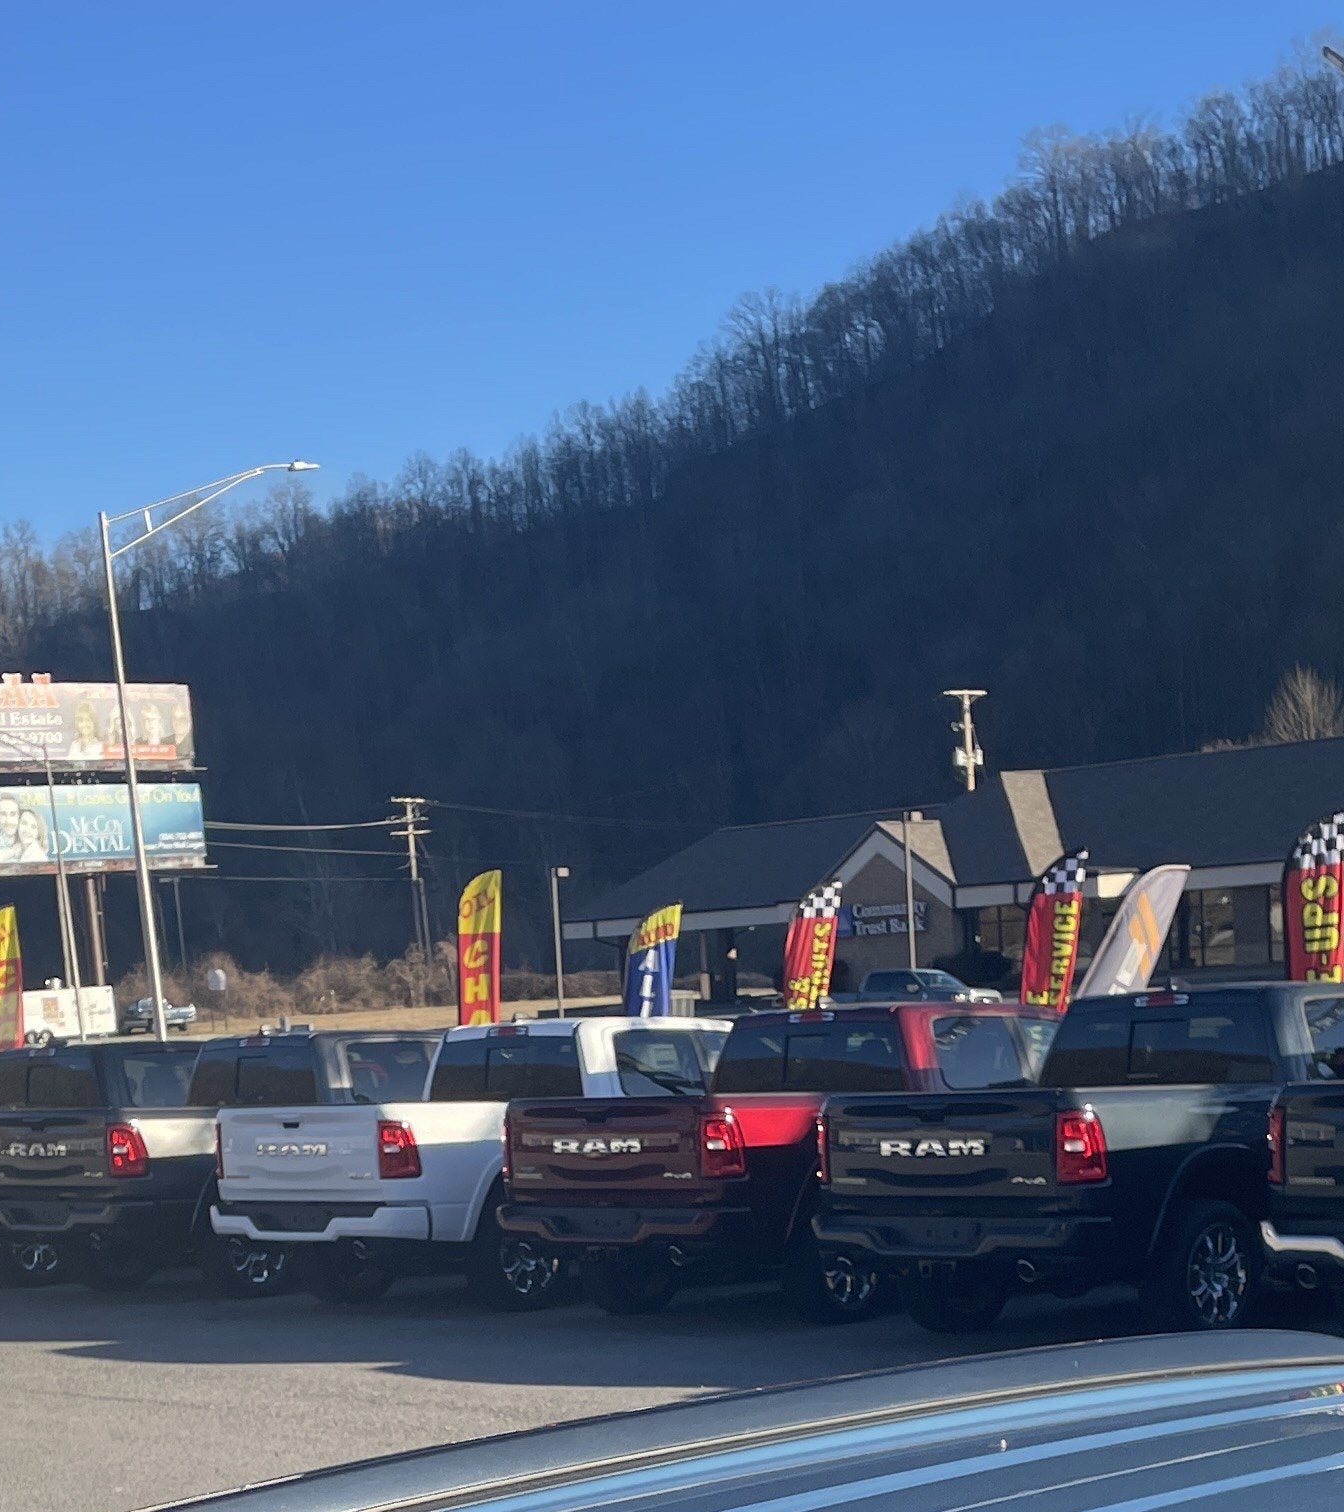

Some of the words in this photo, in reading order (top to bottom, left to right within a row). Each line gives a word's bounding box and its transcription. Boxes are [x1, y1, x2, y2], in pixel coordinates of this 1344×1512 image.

[9, 711, 63, 726] Estate
[115, 788, 152, 804] Gd
[50, 830, 131, 855] DENTAL
[459, 890, 494, 920] OIL
[852, 901, 927, 918] Communy
[889, 917, 925, 935] Bak
[1049, 899, 1079, 1005] SERVICE
[9, 1143, 67, 1157] RAM
[552, 1138, 641, 1154] RAM
[880, 1138, 987, 1157] RAM
